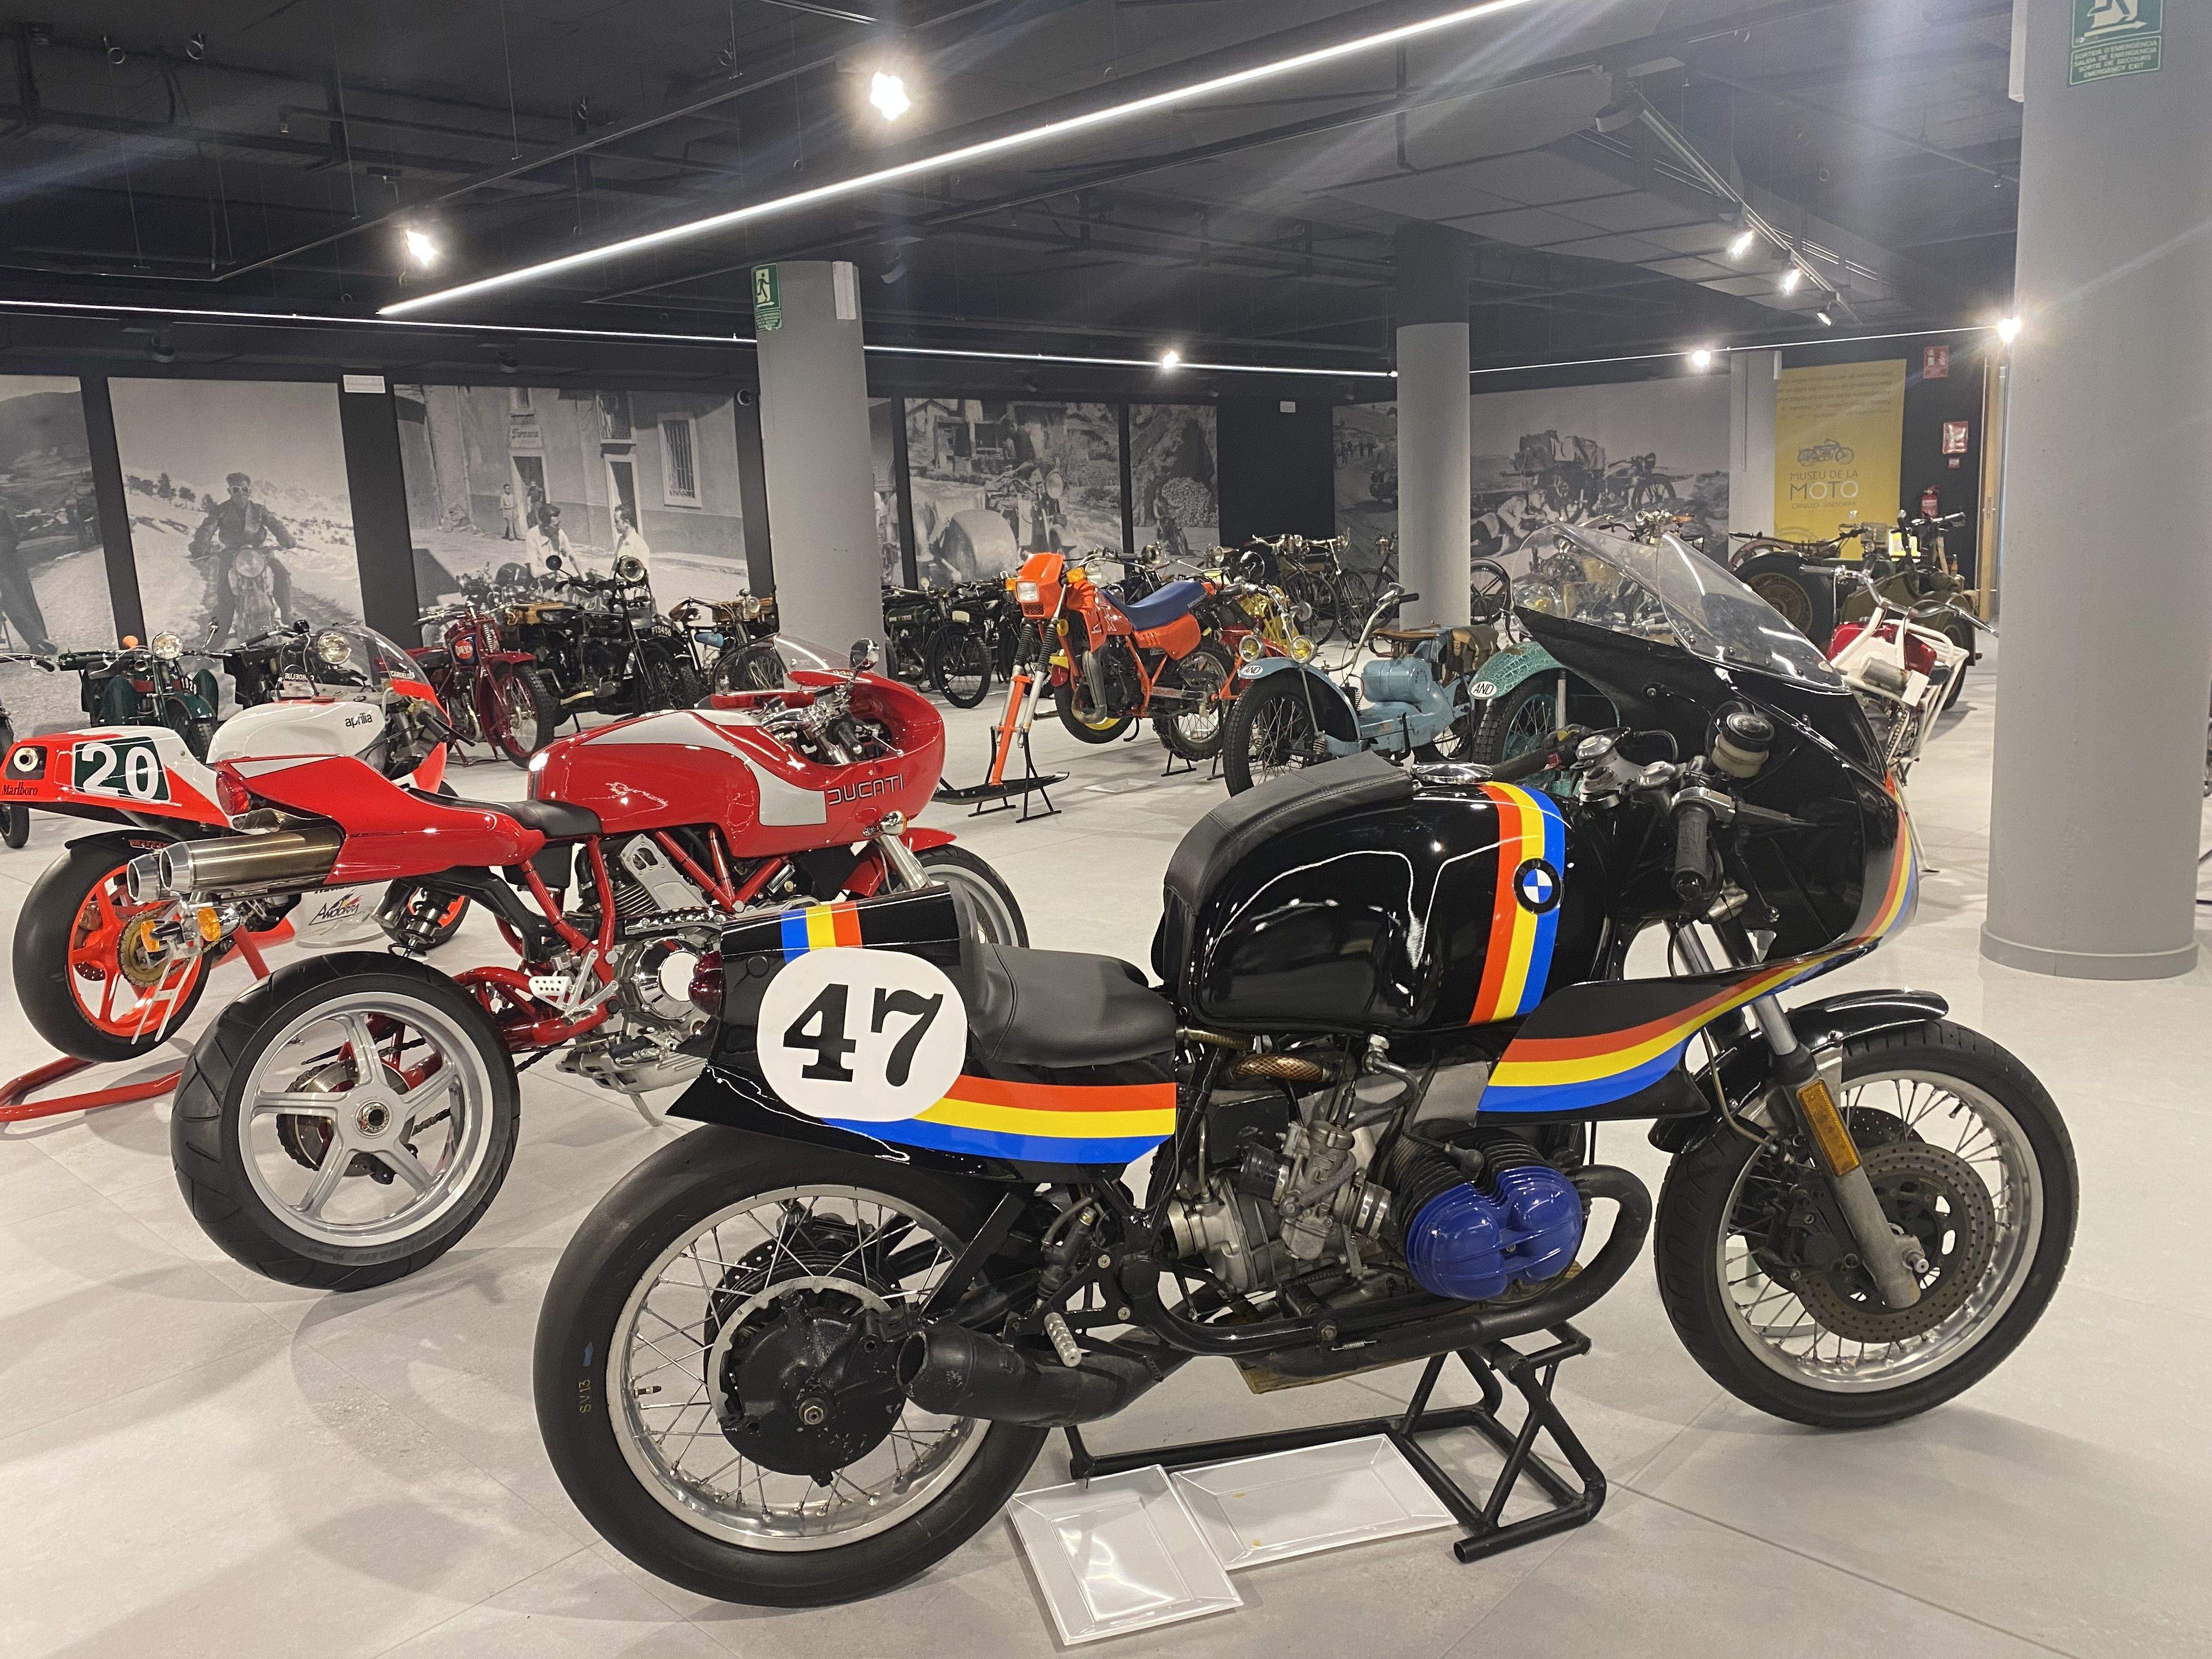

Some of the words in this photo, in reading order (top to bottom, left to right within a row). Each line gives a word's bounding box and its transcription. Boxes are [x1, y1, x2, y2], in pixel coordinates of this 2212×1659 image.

[2074, 57, 2096, 67] SALIDA
[2078, 62, 2102, 72] SORTIE
[2117, 54, 2151, 65] SECOURS
[2084, 65, 2126, 78] EMERGENCY
[1790, 471, 1826, 481] MUSEU
[1830, 470, 1843, 479] DE
[1847, 470, 1858, 478] LA
[1790, 480, 1859, 500] MOTO
[1243, 666, 1261, 674] AND
[1472, 682, 1494, 695] AND
[81, 742, 159, 800] 20
[1, 781, 38, 795] Marlboro
[827, 772, 905, 806] DUCATI
[782, 983, 944, 1087] 47
